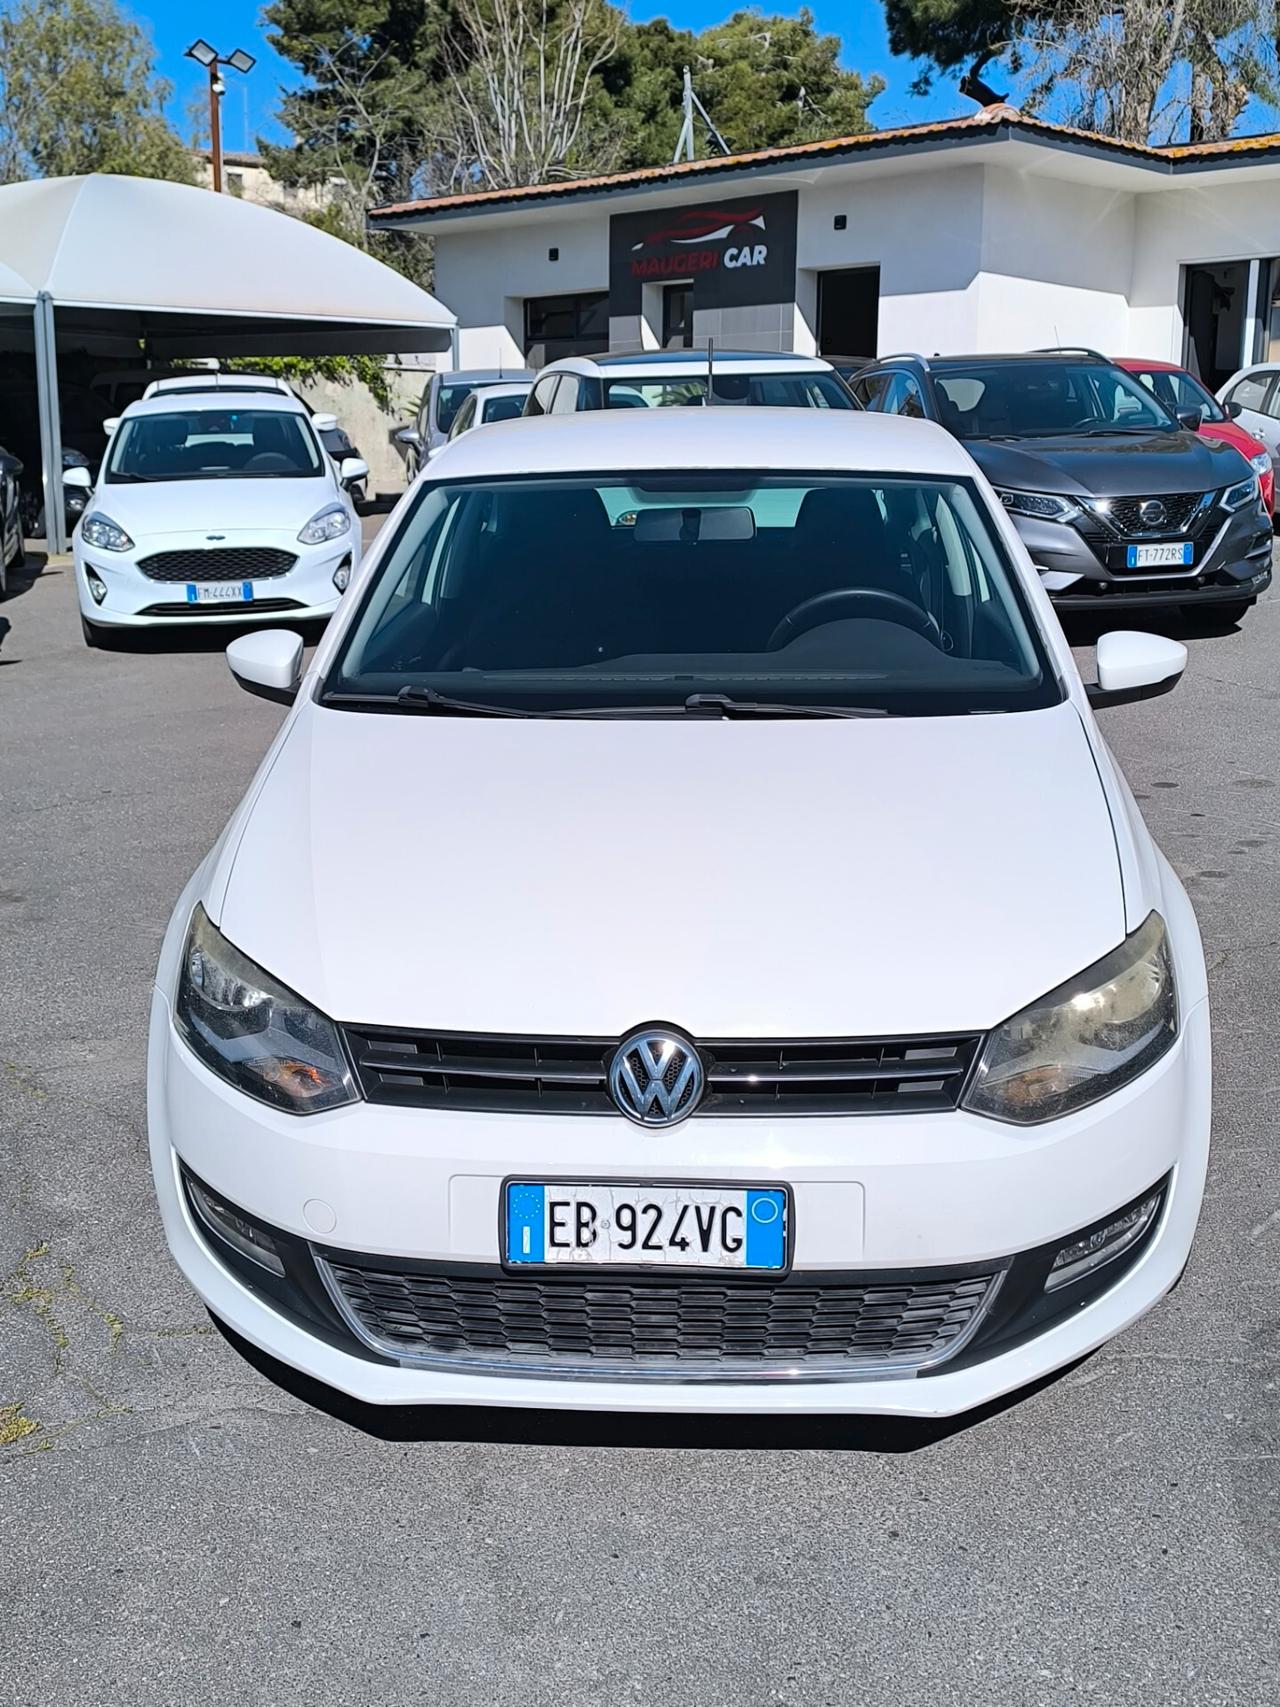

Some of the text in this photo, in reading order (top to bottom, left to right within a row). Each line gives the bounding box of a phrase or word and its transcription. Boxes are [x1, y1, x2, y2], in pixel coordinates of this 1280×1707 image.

[631, 245, 768, 276] MAUGERI CAR
[549, 1201, 743, 1253] EB 924VG
